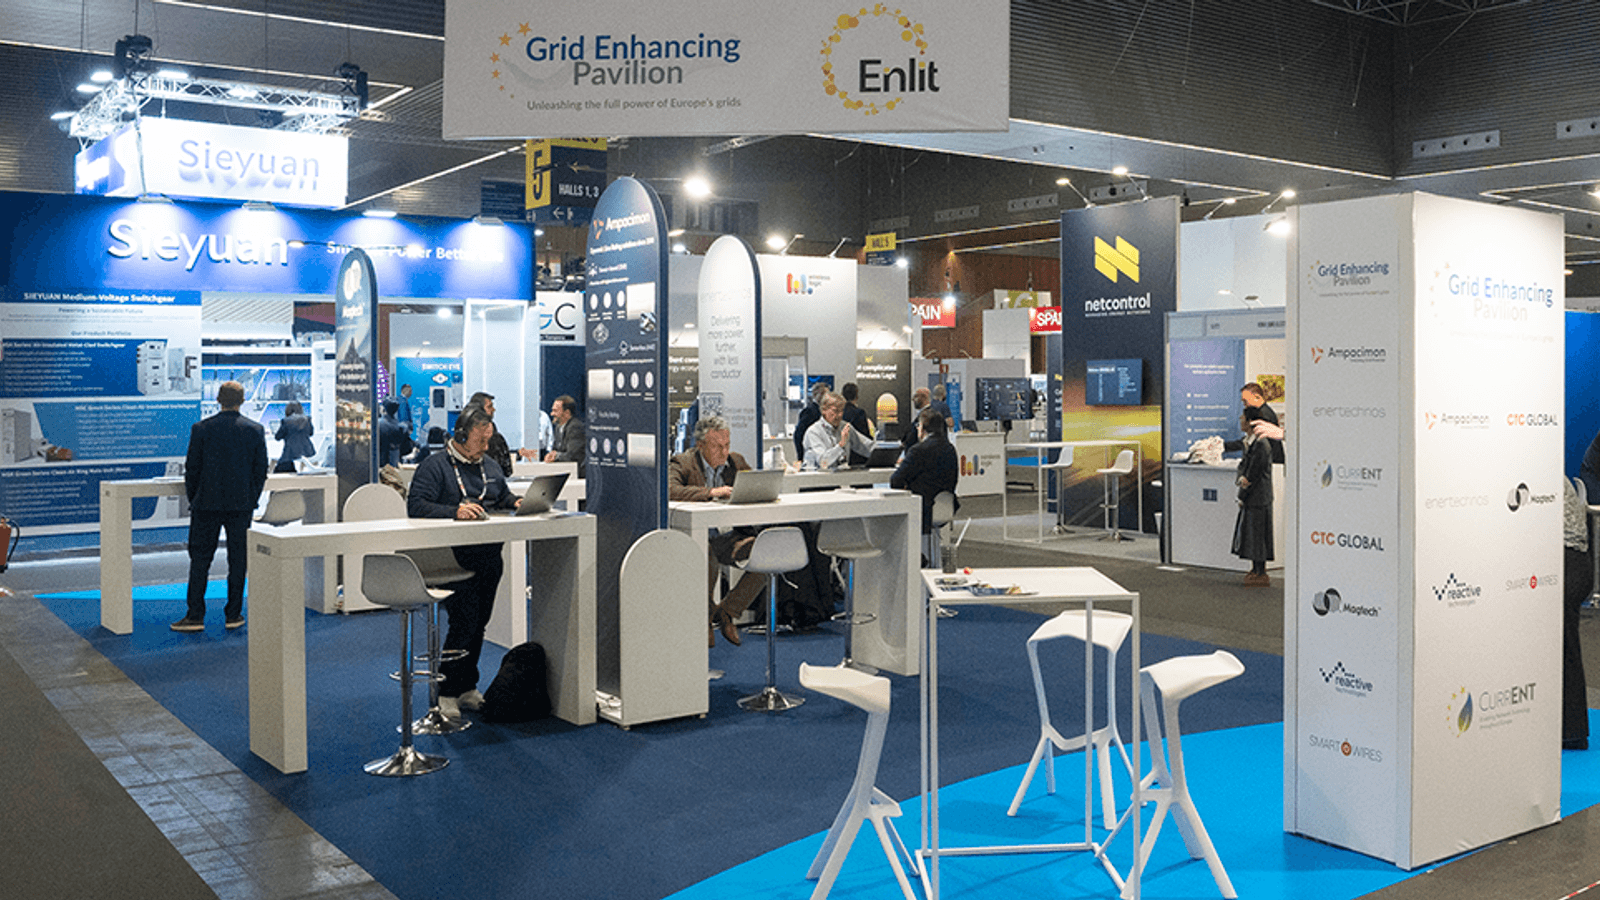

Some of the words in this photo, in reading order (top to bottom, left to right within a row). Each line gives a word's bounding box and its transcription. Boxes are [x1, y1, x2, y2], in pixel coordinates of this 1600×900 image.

[526, 35, 585, 61] Grid
[595, 33, 741, 63] Enhancing
[573, 60, 683, 86] Pavilion
[858, 57, 940, 93] Enlit
[526, 99, 582, 111] Unleashing
[585, 99, 601, 109] the
[603, 99, 620, 109] full
[622, 100, 654, 111] power
[656, 98, 669, 108] of
[670, 98, 715, 109] Europe's
[716, 97, 741, 109] grids
[178, 139, 320, 179] Sieyuan
[558, 183, 584, 197] HALLS
[605, 212, 651, 232] Ampacimon
[107, 218, 289, 273] Sieyuan
[1317, 264, 1339, 277] Grid
[1340, 261, 1390, 276] Enhancing
[1333, 275, 1372, 287] Pavilion
[1448, 274, 1480, 297] Grid
[1484, 277, 1554, 308] Enhancing
[1084, 292, 1151, 312] netcontrol
[1473, 298, 1529, 322] Pavilion
[911, 303, 942, 321] PAIN
[1327, 346, 1387, 360] Ampacimon
[1312, 406, 1387, 419] enertechnos
[1441, 412, 1490, 426] Ampacimon
[1506, 413, 1526, 427] CTC
[1526, 413, 1558, 427] GLOBAL
[1310, 531, 1335, 546] CTC
[1337, 533, 1385, 552] GLOBAL
[1447, 585, 1482, 600] reactive
[1335, 675, 1373, 692] reactive
[1308, 734, 1340, 752] SMART
[1353, 746, 1383, 763] WIRES
